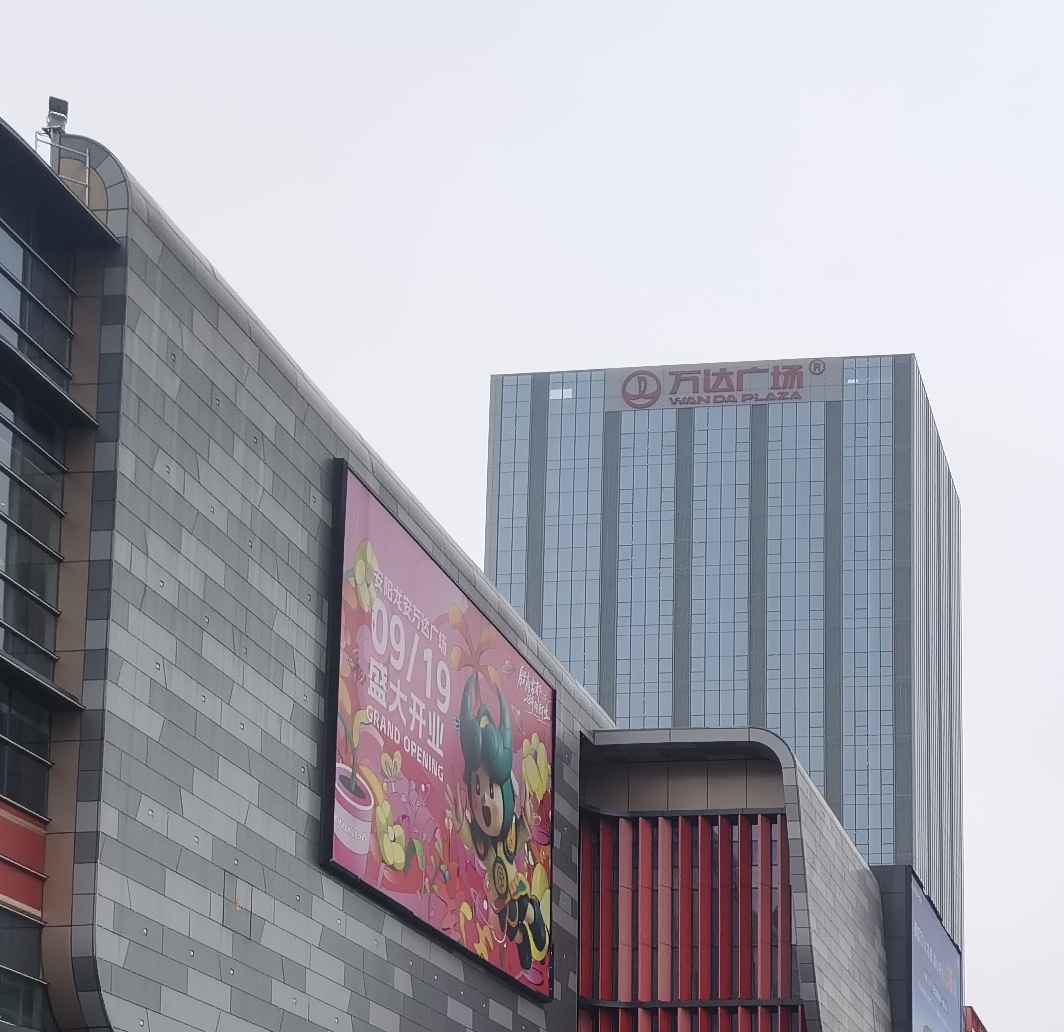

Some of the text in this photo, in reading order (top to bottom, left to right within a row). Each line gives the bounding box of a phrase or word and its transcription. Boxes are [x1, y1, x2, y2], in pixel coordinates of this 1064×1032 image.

[669, 365, 804, 394] 万达广场
[371, 597, 450, 714] 09/19
[366, 705, 444, 782] GRAND OPENING
[368, 657, 444, 758] 盛大开业
